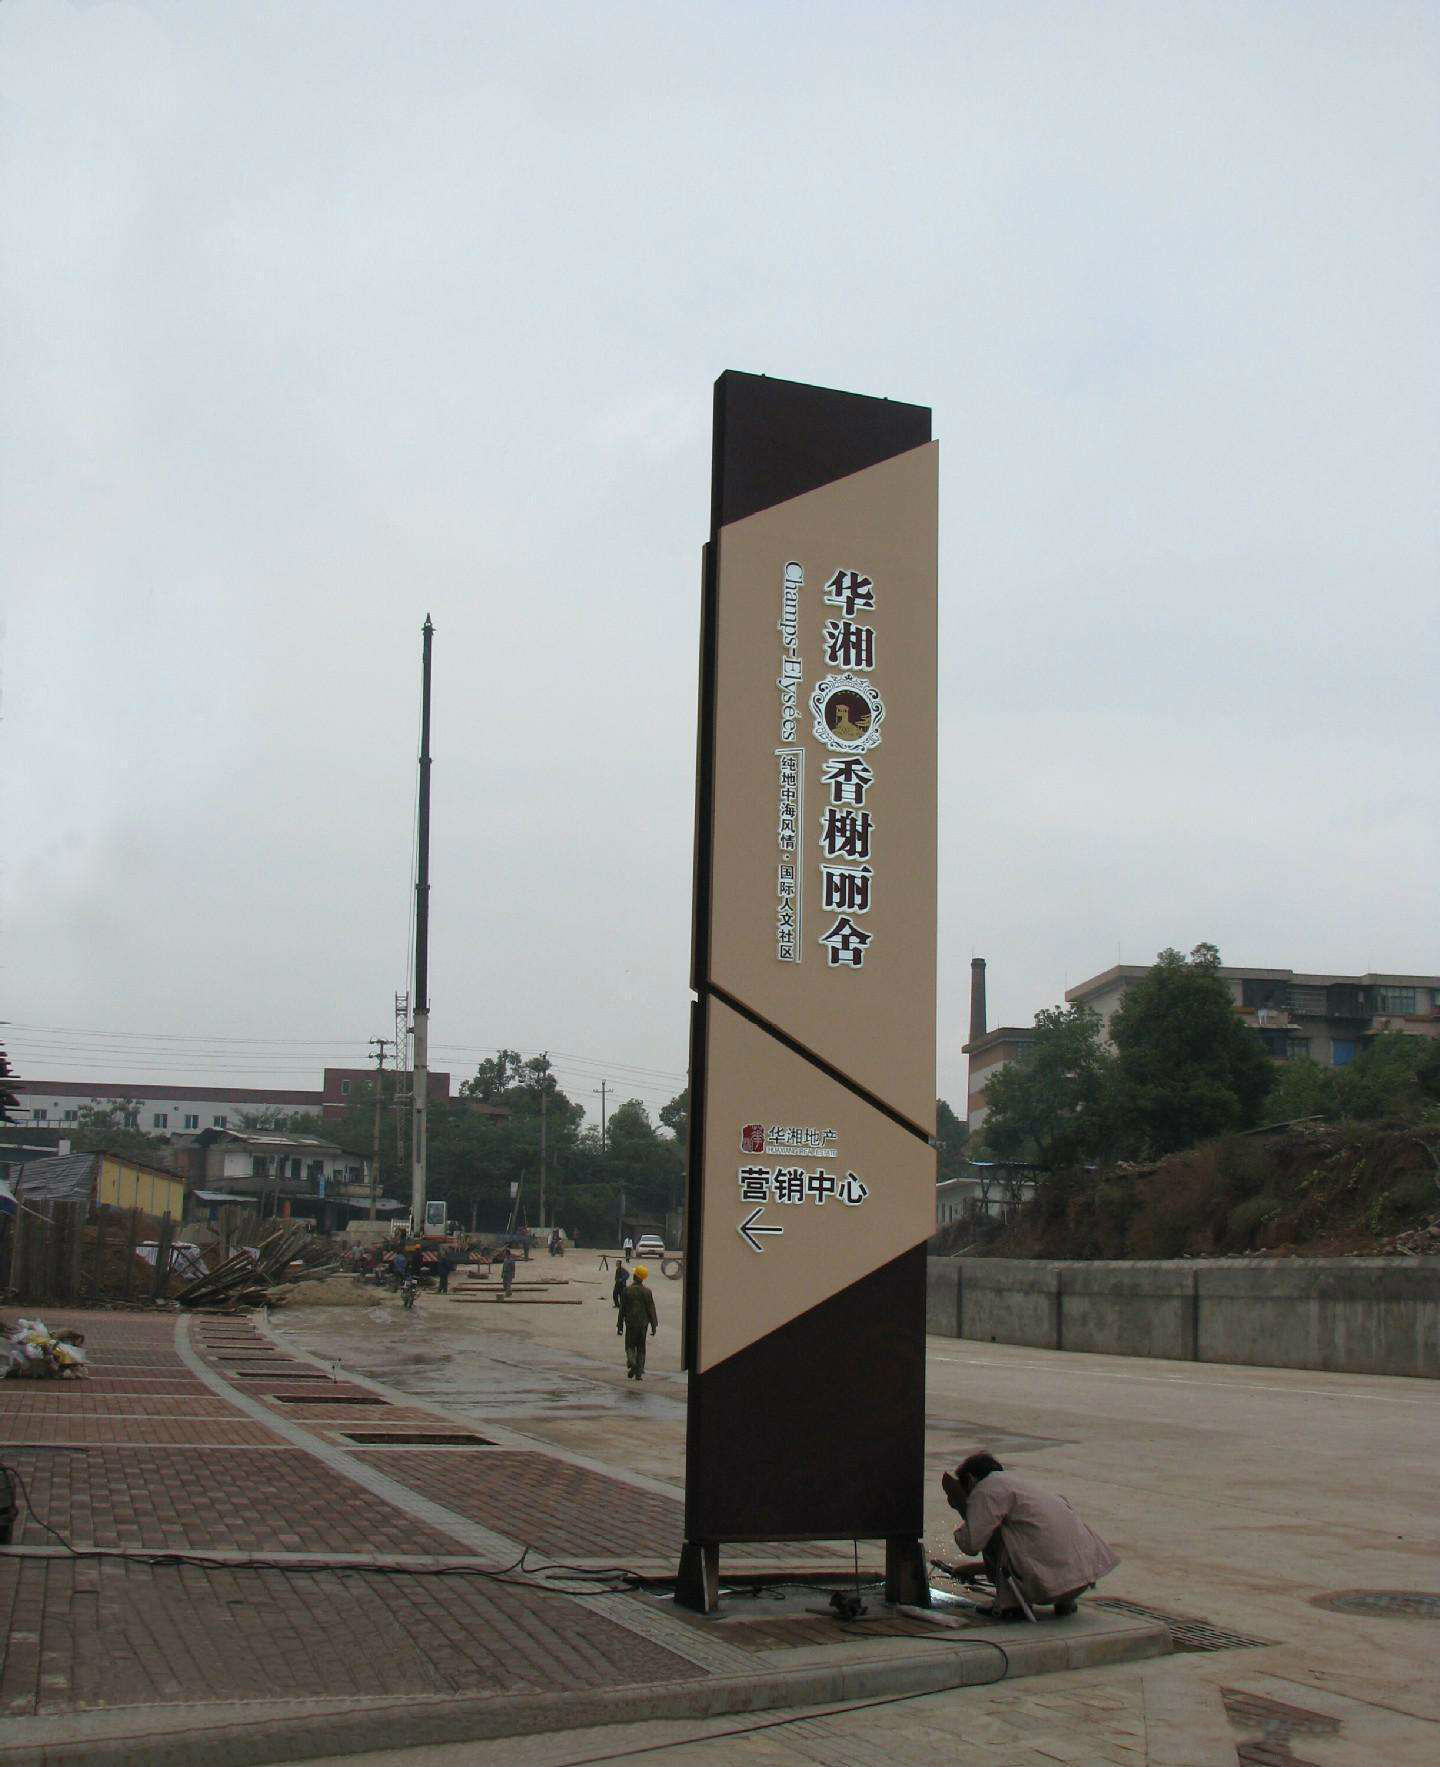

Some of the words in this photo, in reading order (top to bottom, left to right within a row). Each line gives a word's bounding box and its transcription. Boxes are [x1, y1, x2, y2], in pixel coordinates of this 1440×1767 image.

[826, 569, 875, 669] 华湘
[821, 758, 874, 965] 香榭丽舍
[768, 1126, 838, 1147] 华湘地产
[740, 1167, 868, 1204] 营销中心
